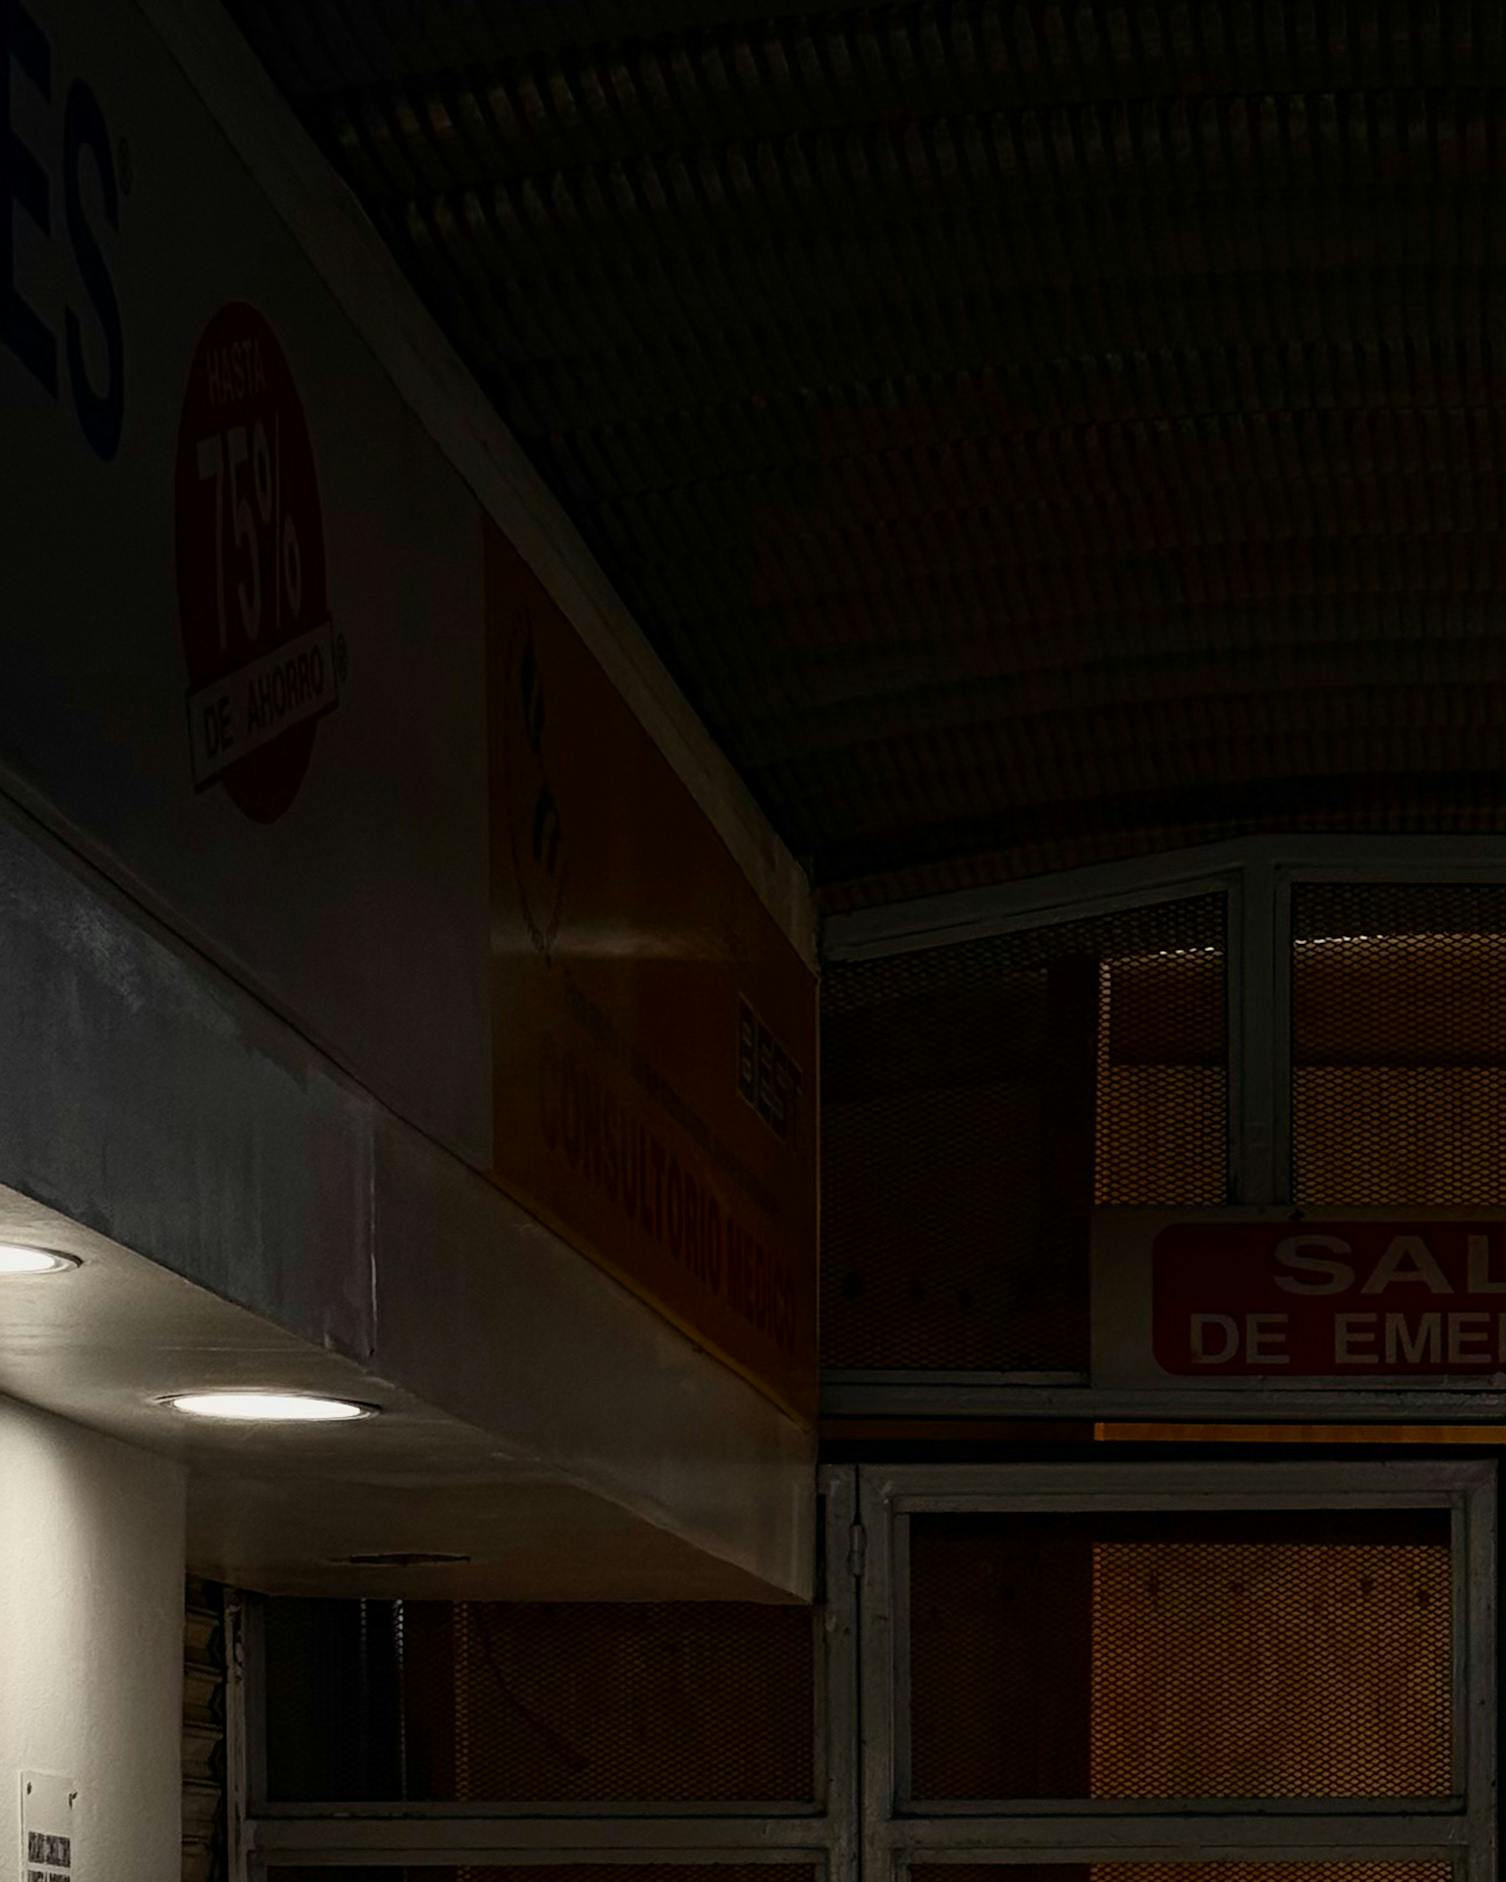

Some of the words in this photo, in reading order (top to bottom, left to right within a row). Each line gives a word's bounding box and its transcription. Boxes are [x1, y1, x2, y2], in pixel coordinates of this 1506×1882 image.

[205, 335, 268, 409] HASTA
[195, 410, 303, 656] 75%
[204, 694, 234, 760] DE
[247, 644, 325, 736] AHORRO
[538, 1030, 724, 1298] CONSULTORIO
[1189, 1311, 1289, 1367] DE
